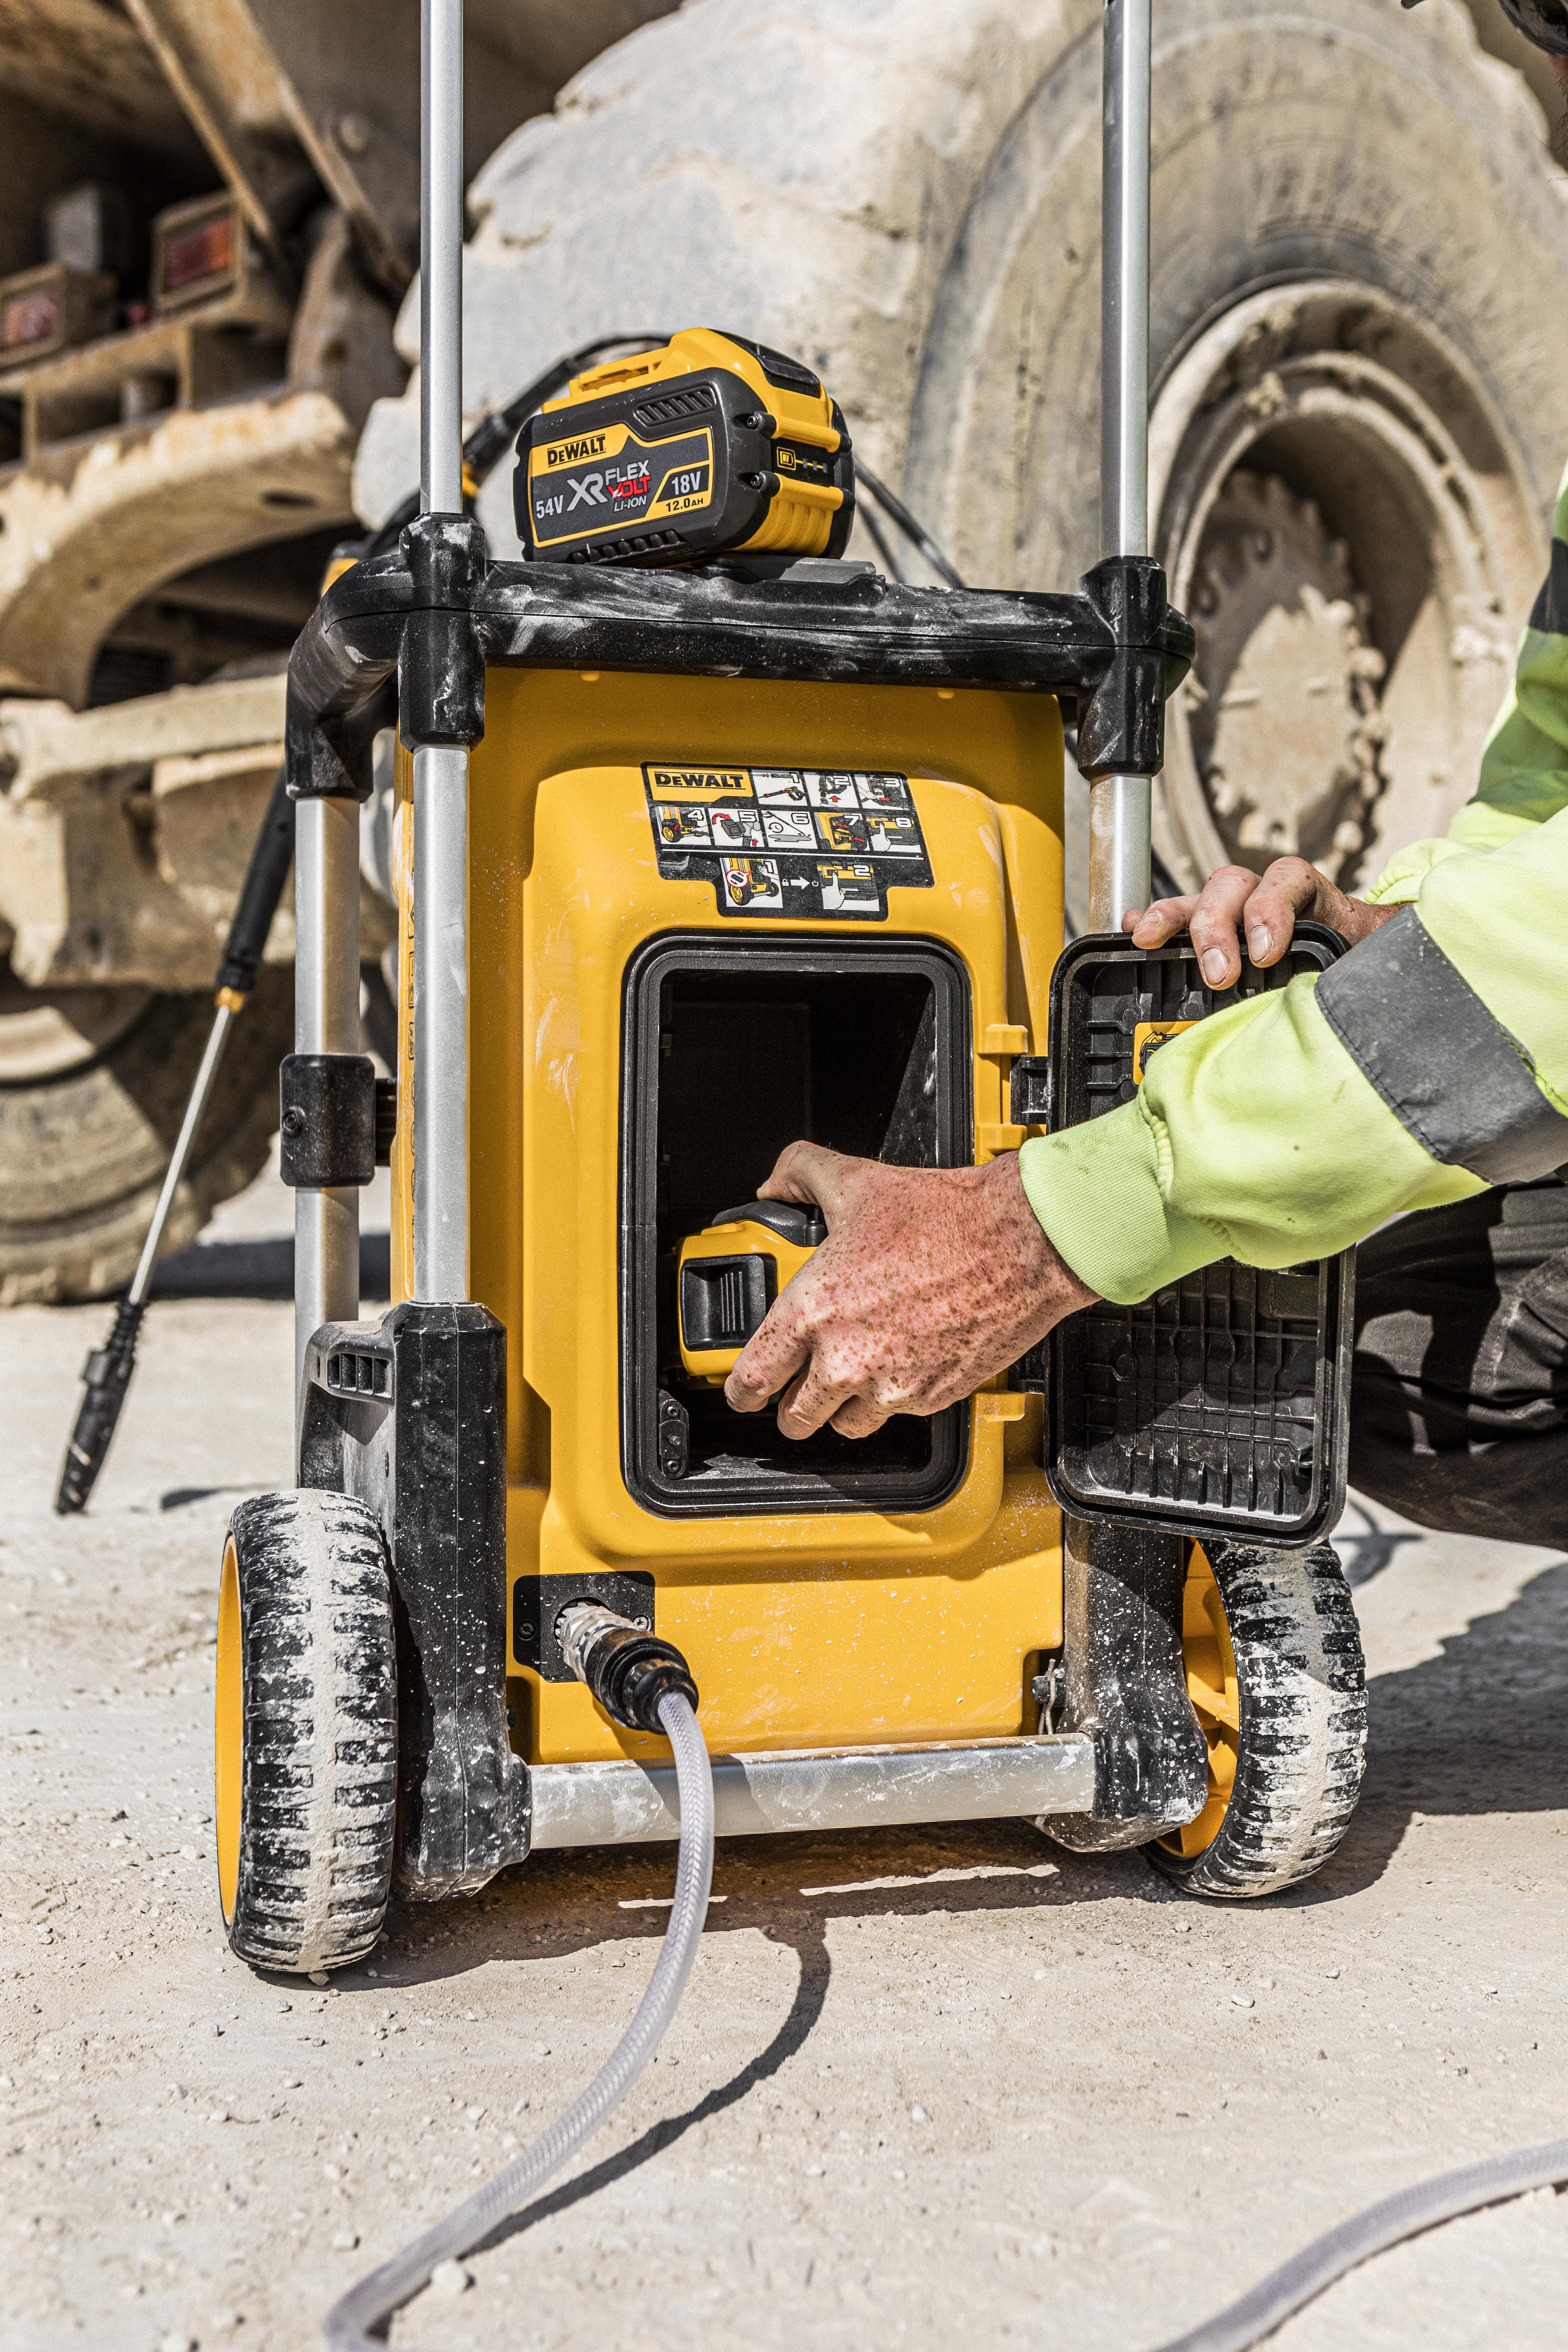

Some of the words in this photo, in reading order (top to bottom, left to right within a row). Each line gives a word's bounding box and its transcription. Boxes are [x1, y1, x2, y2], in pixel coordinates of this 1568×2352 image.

[547, 435, 605, 465] DEWALT
[605, 460, 650, 485] FLEX
[606, 475, 651, 499] VOLT
[672, 471, 701, 495] 18V
[536, 494, 564, 519] 54V
[566, 472, 608, 511] XR
[614, 495, 647, 512] LI-ION
[654, 773, 744, 788] DEWALT
[790, 773, 800, 783] 1
[833, 775, 851, 786] 2
[885, 777, 900, 787] 3
[687, 809, 703, 821] 4
[738, 811, 756, 822] 5
[792, 813, 809, 824] 6
[844, 815, 860, 826] 7
[895, 818, 913, 828] 8
[765, 861, 773, 873] 1
[853, 864, 871, 876] 2
